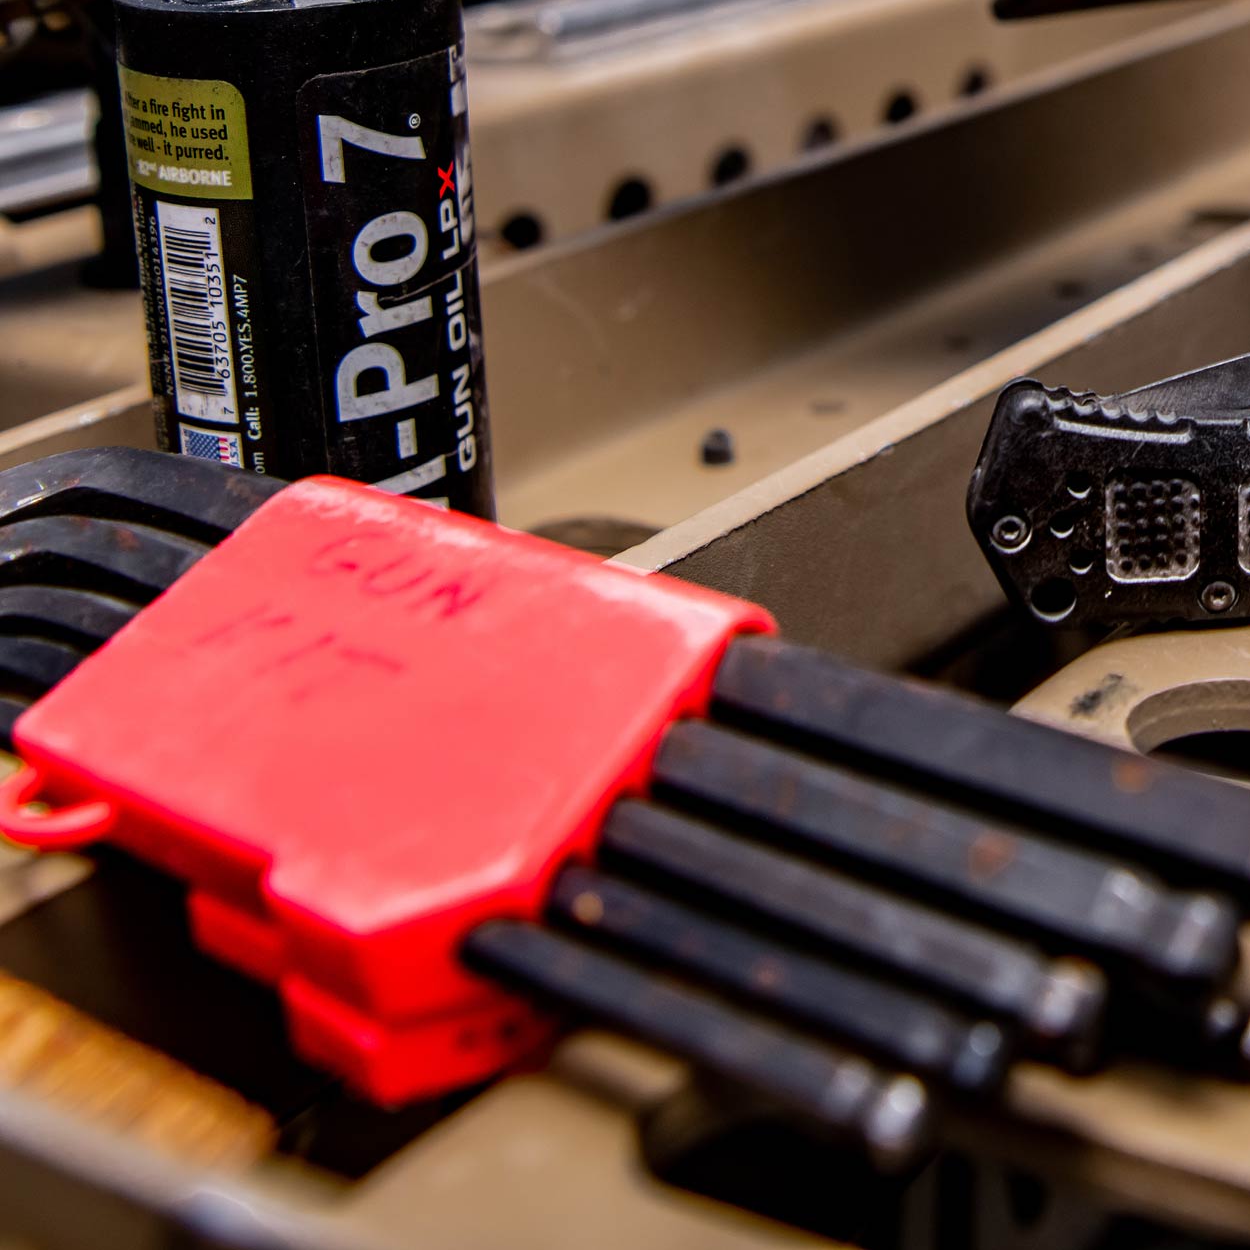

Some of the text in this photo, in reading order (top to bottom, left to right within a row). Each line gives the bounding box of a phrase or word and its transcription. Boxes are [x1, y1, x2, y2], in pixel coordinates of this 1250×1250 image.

[137, 136, 155, 153] well
[163, 140, 173, 156] it
[175, 144, 230, 161] purred.
[142, 100, 148, 113] a
[149, 98, 169, 116] fire
[171, 102, 207, 122] fight
[210, 104, 226, 121] in
[170, 122, 187, 138] he
[191, 124, 228, 141] used
[158, 165, 233, 187] AIRBORNE
[437, 160, 460, 261] LPX
[204, 216, 235, 415] 7 63705 10351 2
[232, 274, 259, 398] 1.800.YES.4MP7
[446, 269, 468, 351] OIL
[246, 406, 263, 441] Call:
[451, 363, 477, 473] GUN
[304, 530, 497, 620] GUN
